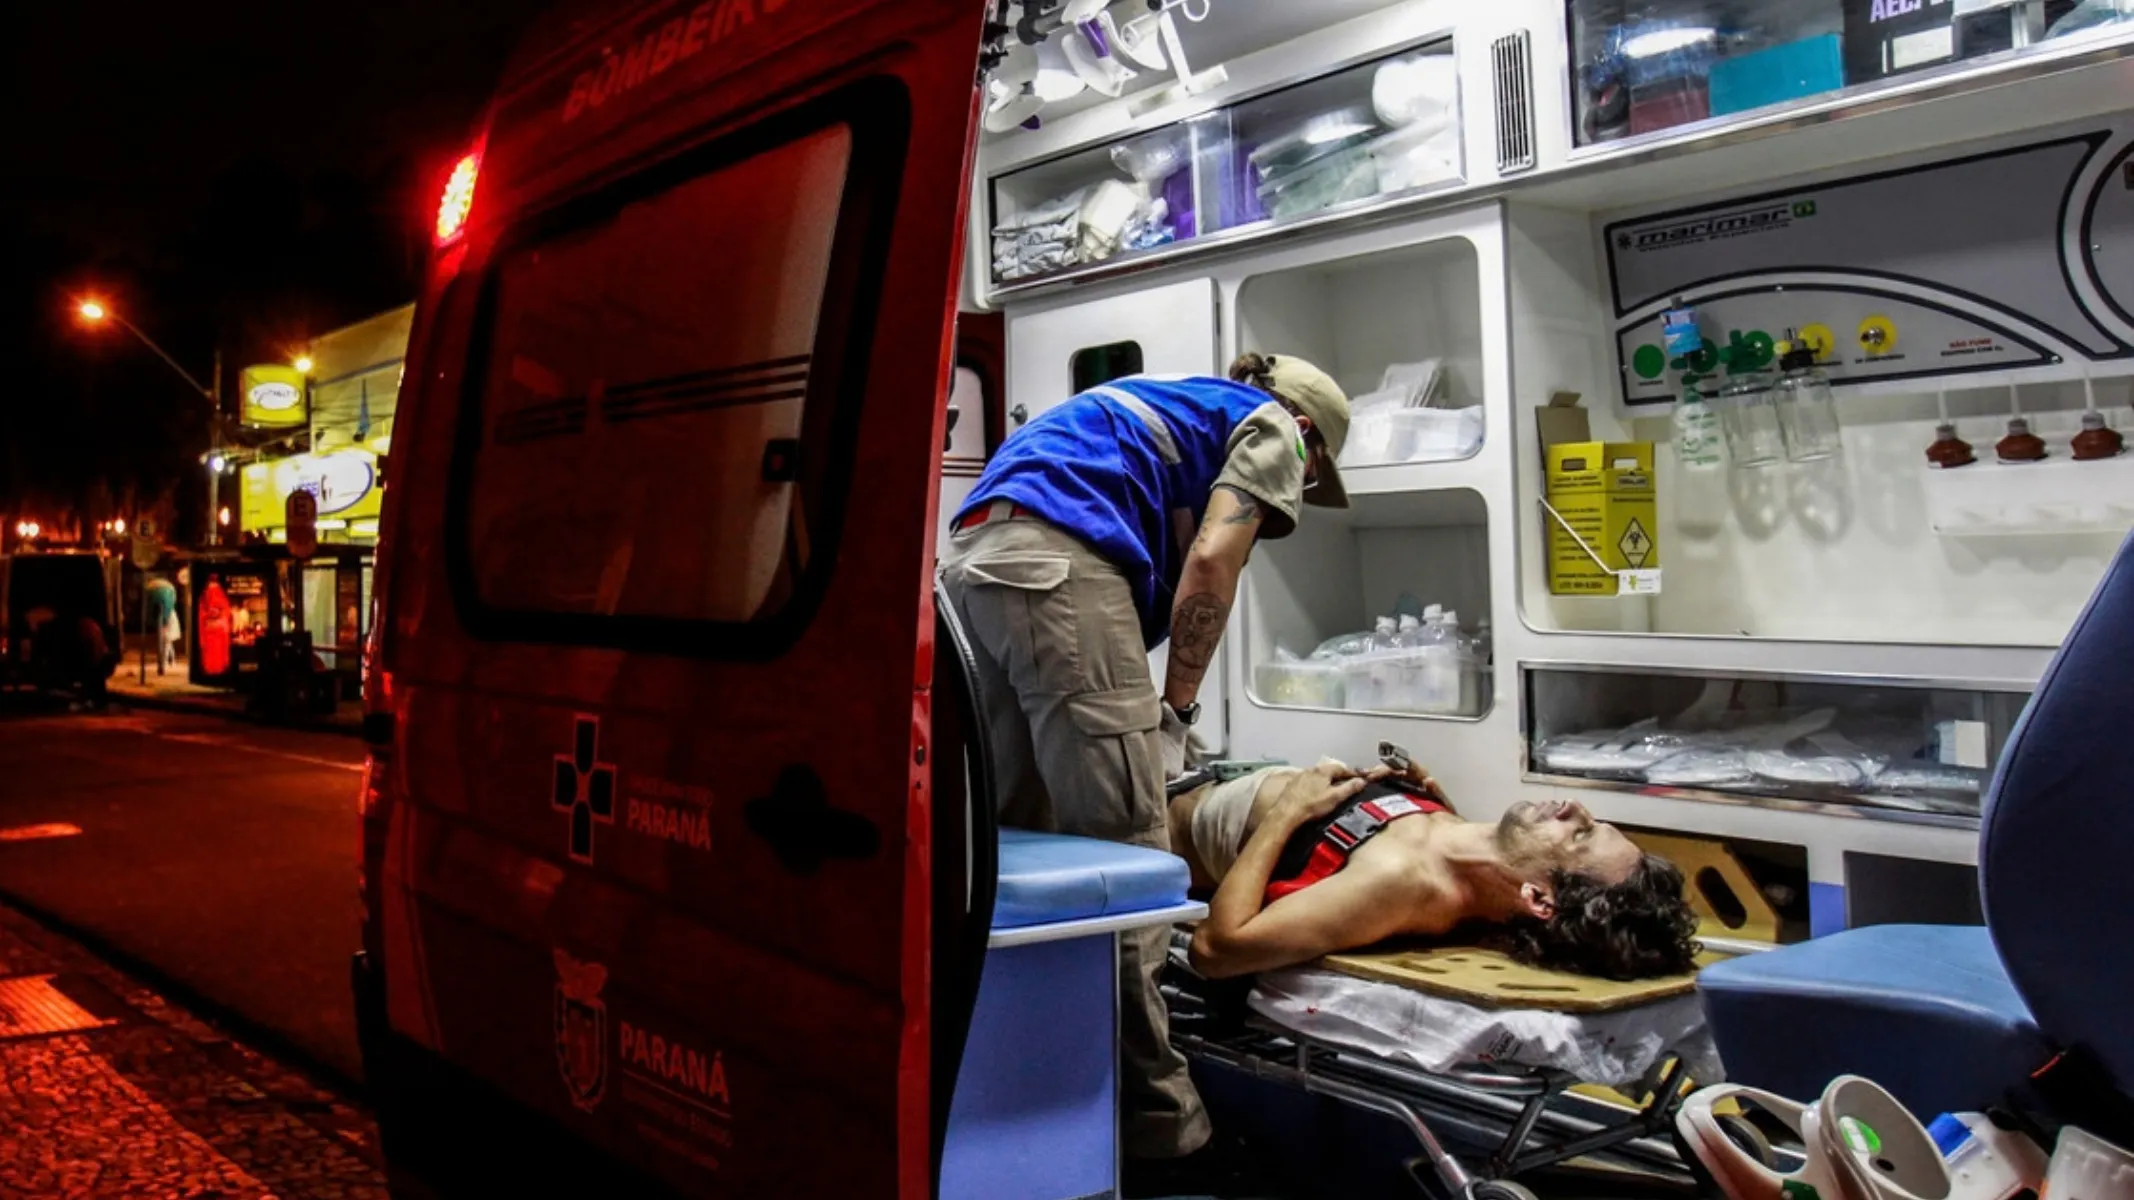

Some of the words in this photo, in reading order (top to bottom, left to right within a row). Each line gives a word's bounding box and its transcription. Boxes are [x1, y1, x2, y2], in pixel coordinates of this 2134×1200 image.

[1638, 208, 1789, 246] marimar
[627, 796, 712, 851] PARANÁ
[619, 1020, 730, 1105] PARANÁ
